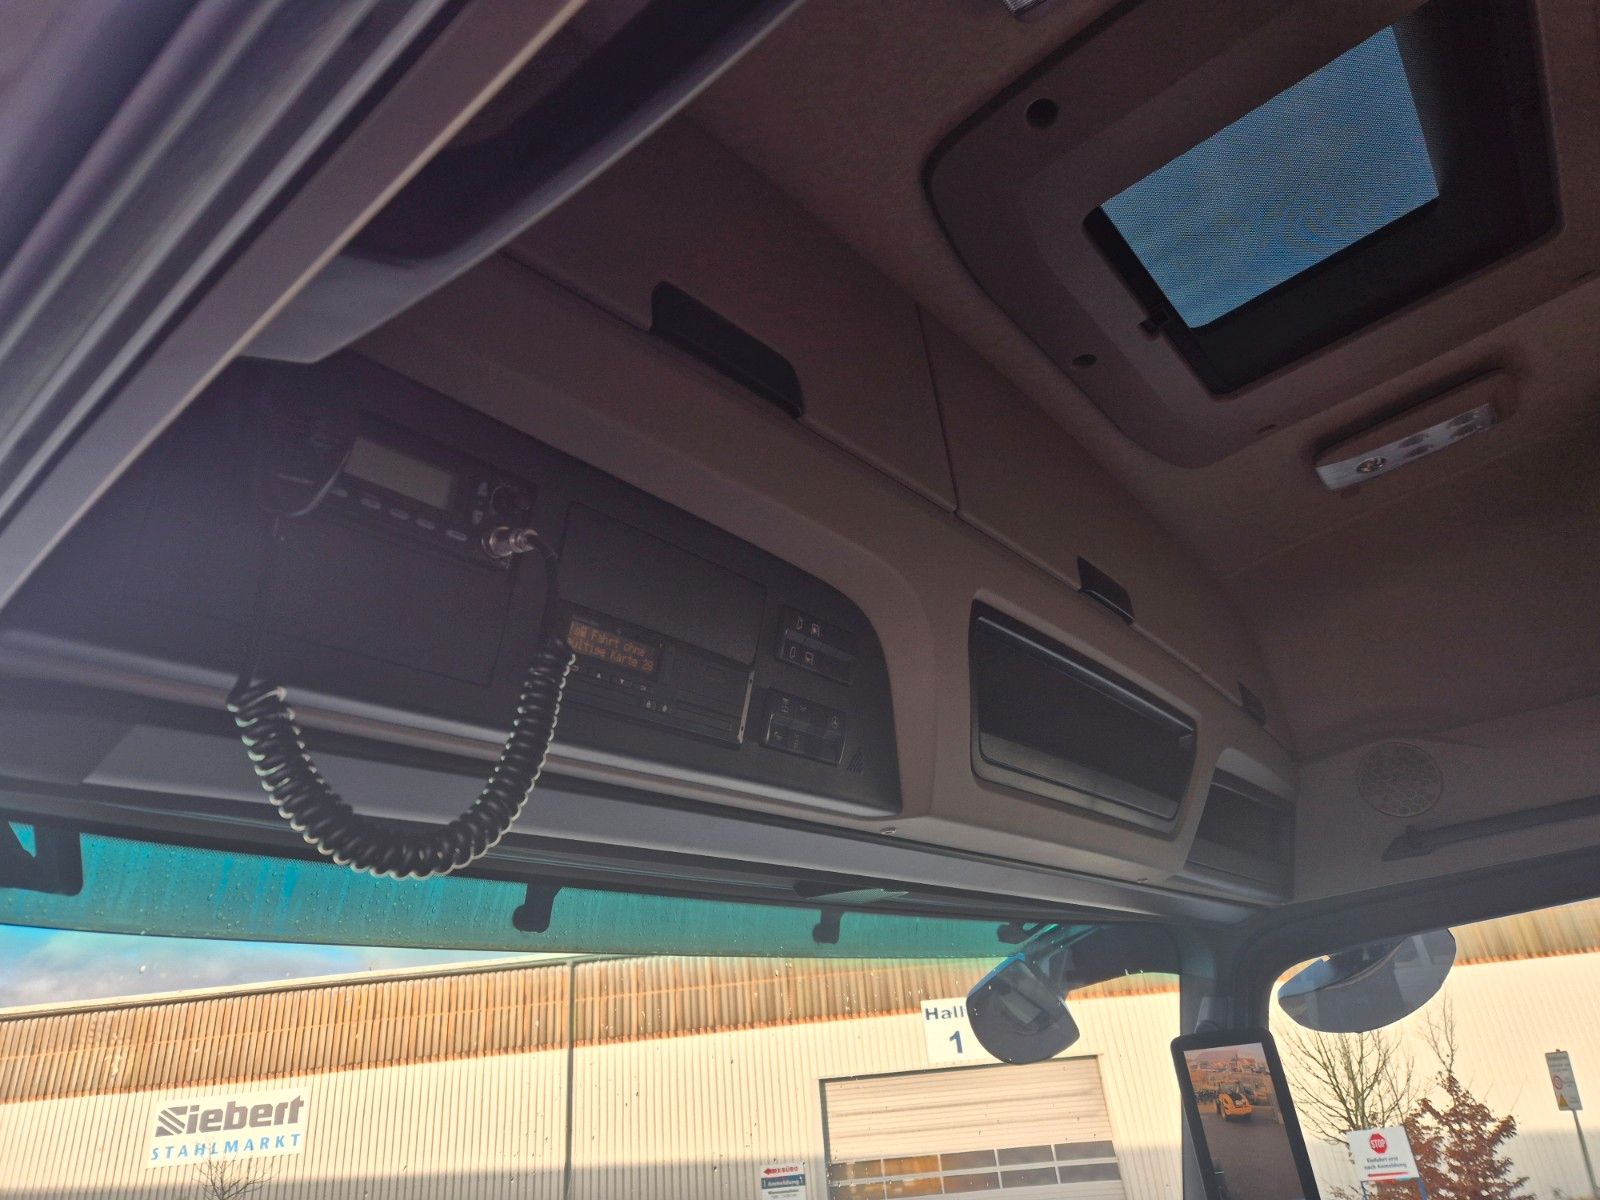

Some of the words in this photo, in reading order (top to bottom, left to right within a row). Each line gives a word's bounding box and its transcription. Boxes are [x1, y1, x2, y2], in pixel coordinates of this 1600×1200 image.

[924, 1005, 967, 1020] Hall
[949, 1030, 963, 1053] 1
[155, 1095, 305, 1137] Siebert
[150, 1133, 301, 1160] STAHLMARKT
[1370, 1139, 1386, 1149] STOP
